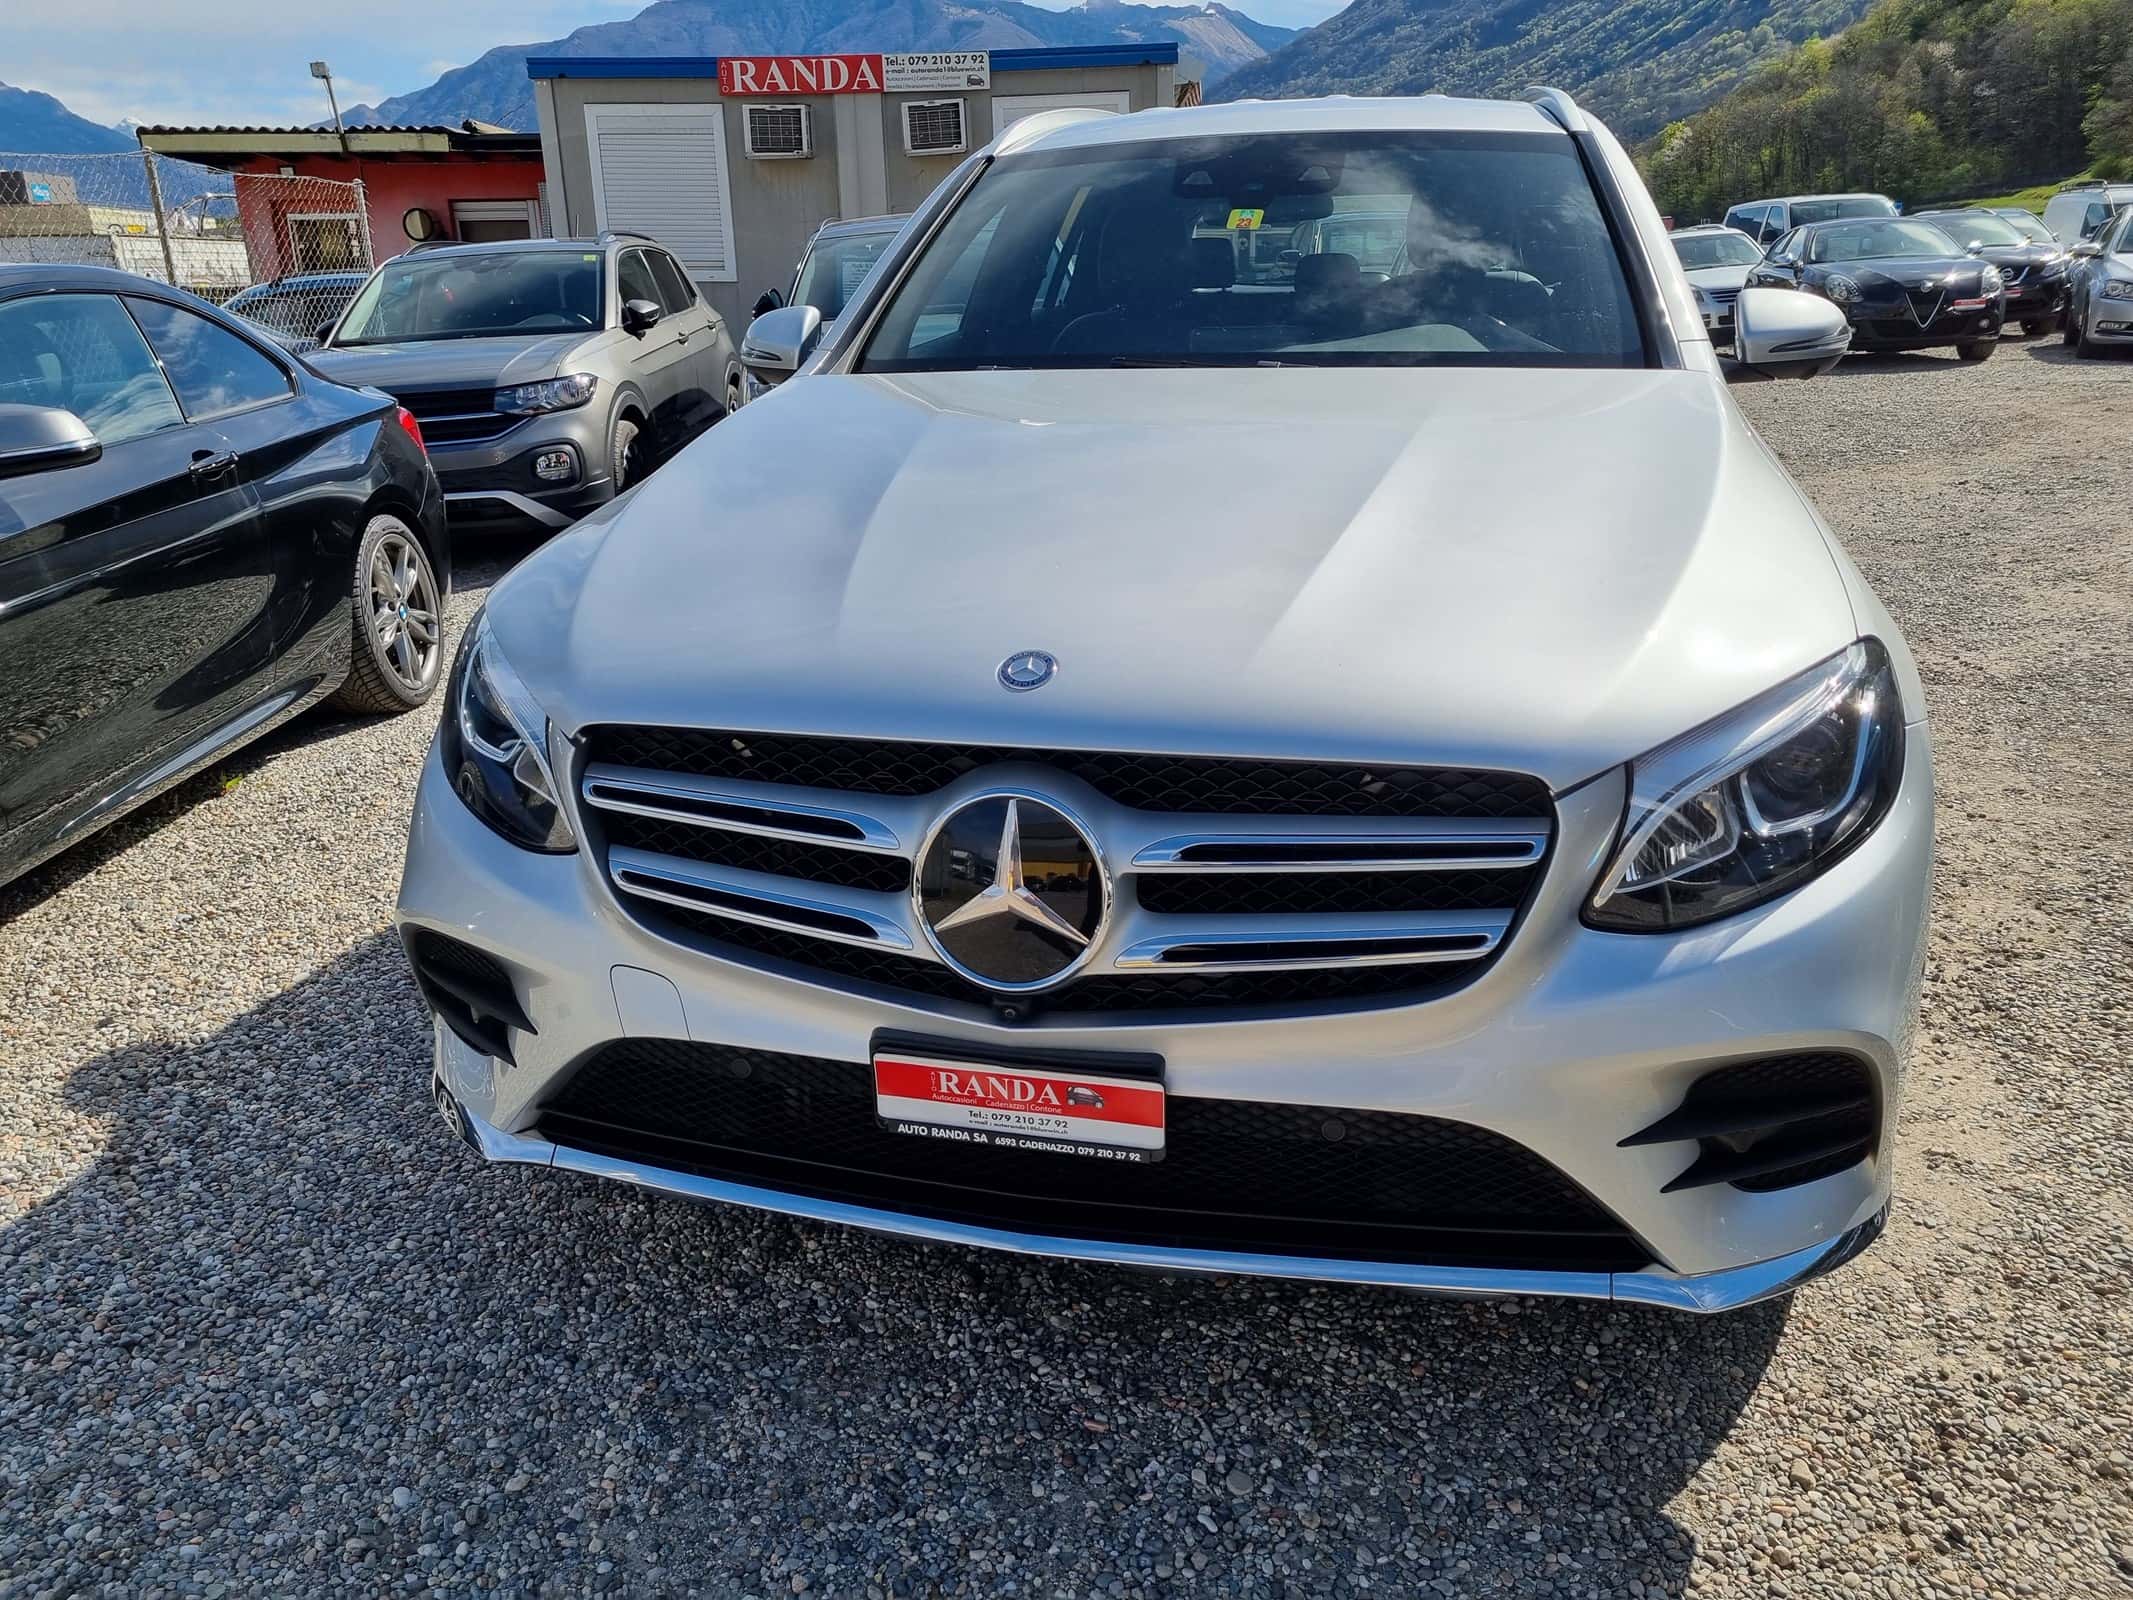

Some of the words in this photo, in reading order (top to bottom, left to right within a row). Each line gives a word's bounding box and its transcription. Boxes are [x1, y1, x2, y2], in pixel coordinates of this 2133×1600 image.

[886, 57, 905, 66] Tel.:
[908, 56, 928, 66] 079
[932, 55, 951, 65] 210
[954, 55, 967, 64] 37
[971, 54, 985, 64] 92
[720, 61, 730, 93] AUTO
[729, 57, 880, 93] RANDA
[1236, 218, 1252, 227] 23
[939, 1071, 1061, 1105] RANDA
[932, 1093, 977, 1105] Autoccasioni
[985, 1099, 1025, 1111] Cadenazzo
[1030, 1104, 1062, 1114] Contone
[968, 1110, 989, 1120] Tel.:
[991, 1112, 1012, 1122] 079
[1015, 1115, 1034, 1125] 210
[1038, 1117, 1051, 1127] 37
[1055, 1119, 1068, 1129] 92
[898, 1123, 928, 1136] AUTO
[931, 1127, 970, 1141] RANDA
[973, 1132, 988, 1143] SA
[995, 1136, 1016, 1147] 6593
[1019, 1139, 1075, 1154] CADENAZZO
[1077, 1147, 1095, 1156] 079
[1097, 1149, 1113, 1159] 210
[1115, 1151, 1126, 1160] 37
[1128, 1152, 1141, 1162] 92
